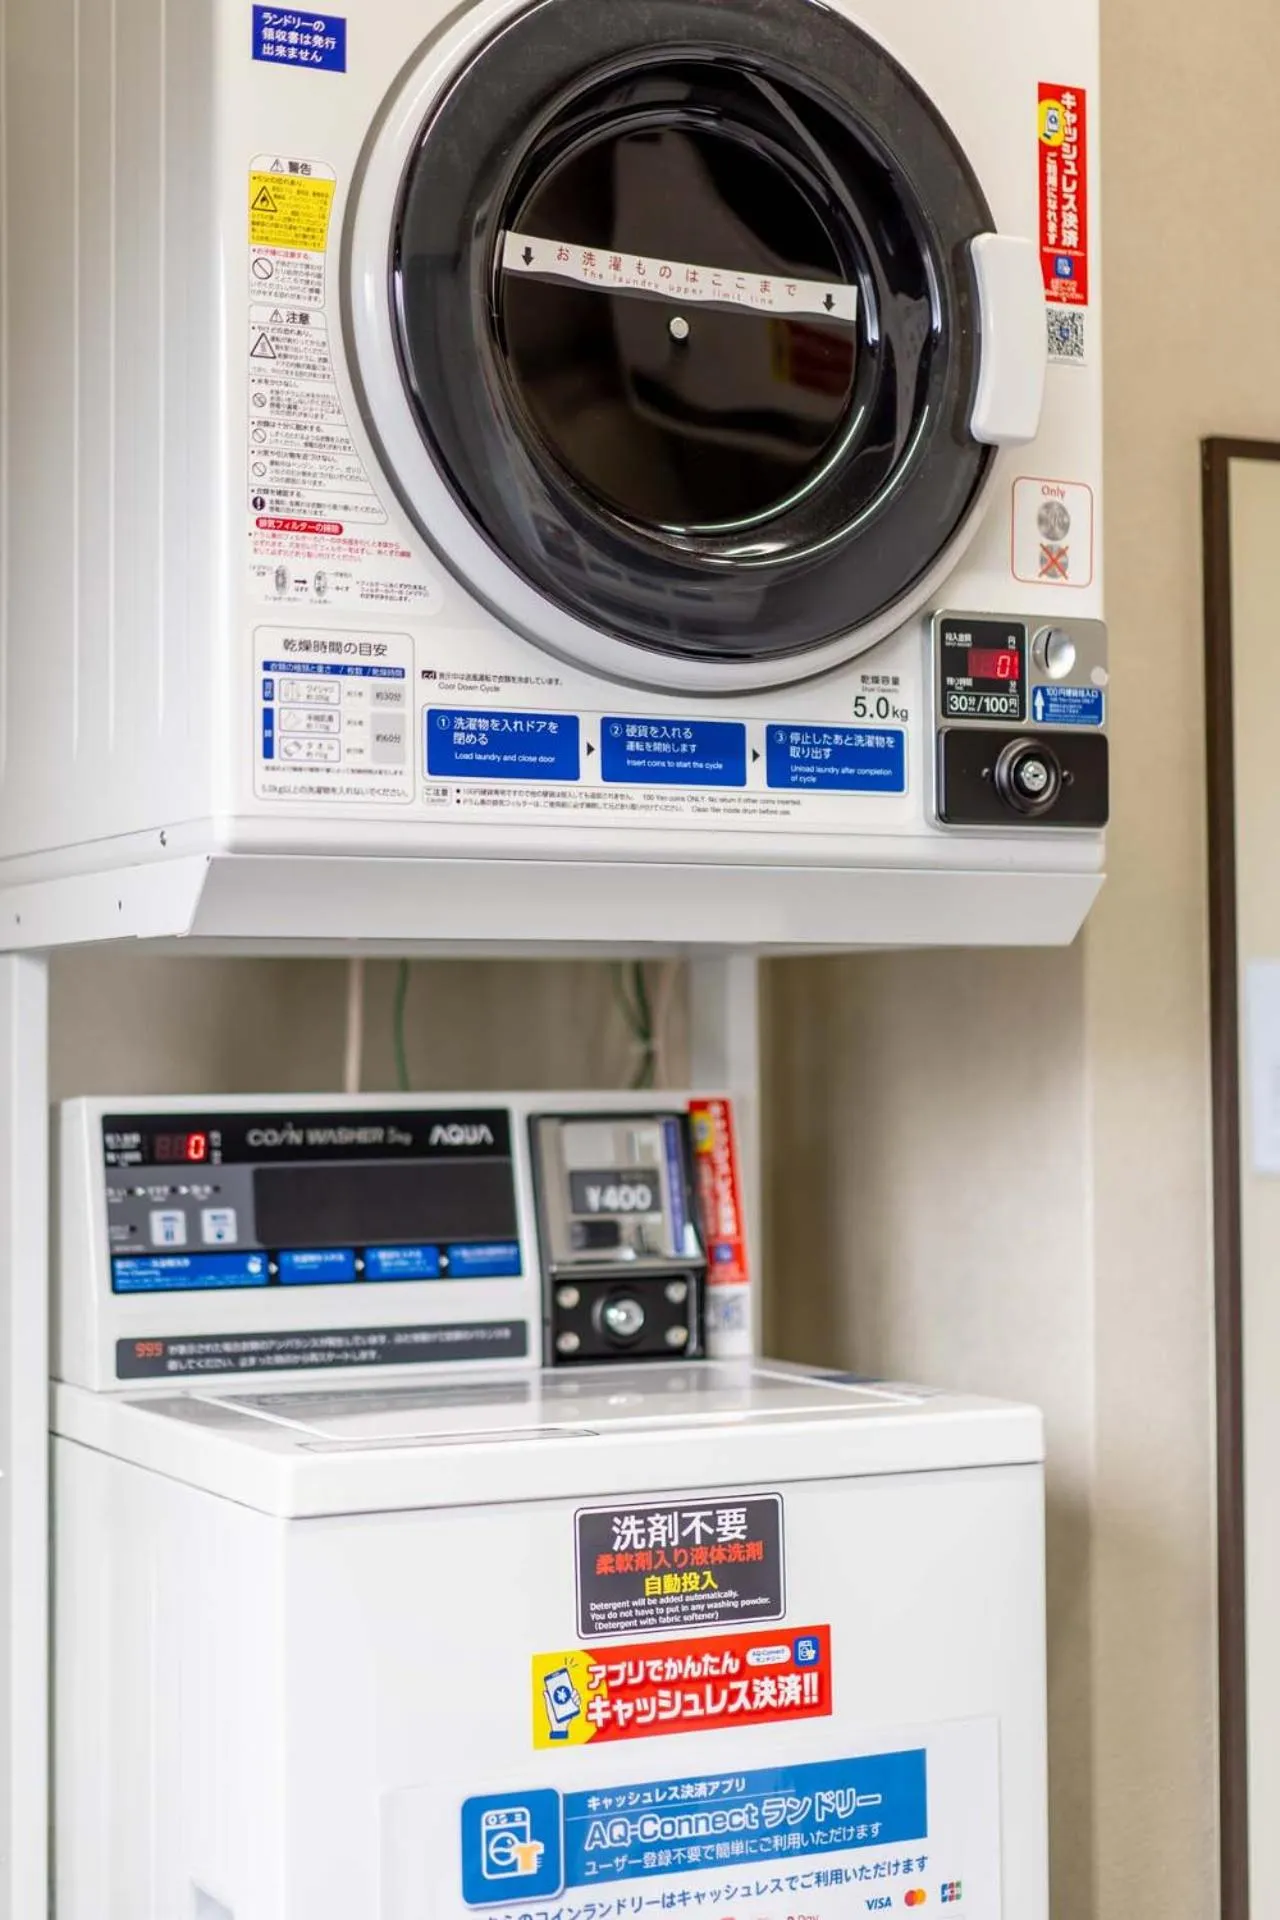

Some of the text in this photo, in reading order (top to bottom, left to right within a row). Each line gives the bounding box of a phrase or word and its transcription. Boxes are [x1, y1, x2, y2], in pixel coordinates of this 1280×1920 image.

[262, 12, 326, 32] ランドリーの
[262, 27, 337, 50] 領収書は発行
[262, 43, 323, 63] 出来ません
[288, 161, 312, 175] 警告
[556, 246, 798, 297] お洗濯ものはここまで
[583, 268, 604, 281] The
[286, 311, 310, 324] 注意
[1041, 485, 1065, 499] Only
[283, 639, 388, 657] 乾燥時間の目安
[996, 654, 1011, 678] 0
[861, 675, 901, 686] 乾燥容量
[453, 716, 559, 734] 洗濯物を入れドアを
[625, 724, 693, 740] 硬貨を入れる
[453, 733, 489, 746] 閉める
[625, 740, 697, 754] 運転を開始します
[790, 731, 896, 749] 停止したあと洗濯物を
[454, 752, 556, 764] Load laundry and close door
[790, 746, 832, 760] 取り出す
[626, 758, 646, 767] Insert
[647, 760, 666, 768] coins
[676, 761, 692, 769] start
[693, 761, 704, 769] the
[705, 761, 724, 771] cycle
[790, 764, 894, 777] Unload laundry after completion
[790, 775, 817, 785] of cycle
[306, 1126, 385, 1146] WASHER
[428, 1124, 494, 1146] AQUA
[187, 1134, 205, 1160] 0
[586, 1184, 652, 1212] ¥400
[612, 1507, 749, 1552] 洗剤不要
[595, 1540, 764, 1576] 柔軟剤入り液体洗剤
[644, 1571, 719, 1597] 自動投入
[589, 1601, 630, 1612] Detergent
[632, 1598, 646, 1607] will
[659, 1595, 684, 1605] added
[685, 1590, 739, 1603] automatically.
[590, 1597, 771, 1621] You do not have to put in any washing powder.
[594, 1611, 719, 1631] (Detergent with fabric softener)
[588, 1651, 741, 1690] アプリでかんたん
[587, 1776, 747, 1812] キャッシュレス決済アプリ
[584, 1788, 883, 1851] AQ-Connect ランドリー
[584, 1821, 884, 1876] ユーザー登録不要で簡単にご利用いただけます
[866, 1896, 893, 1911] VISA
